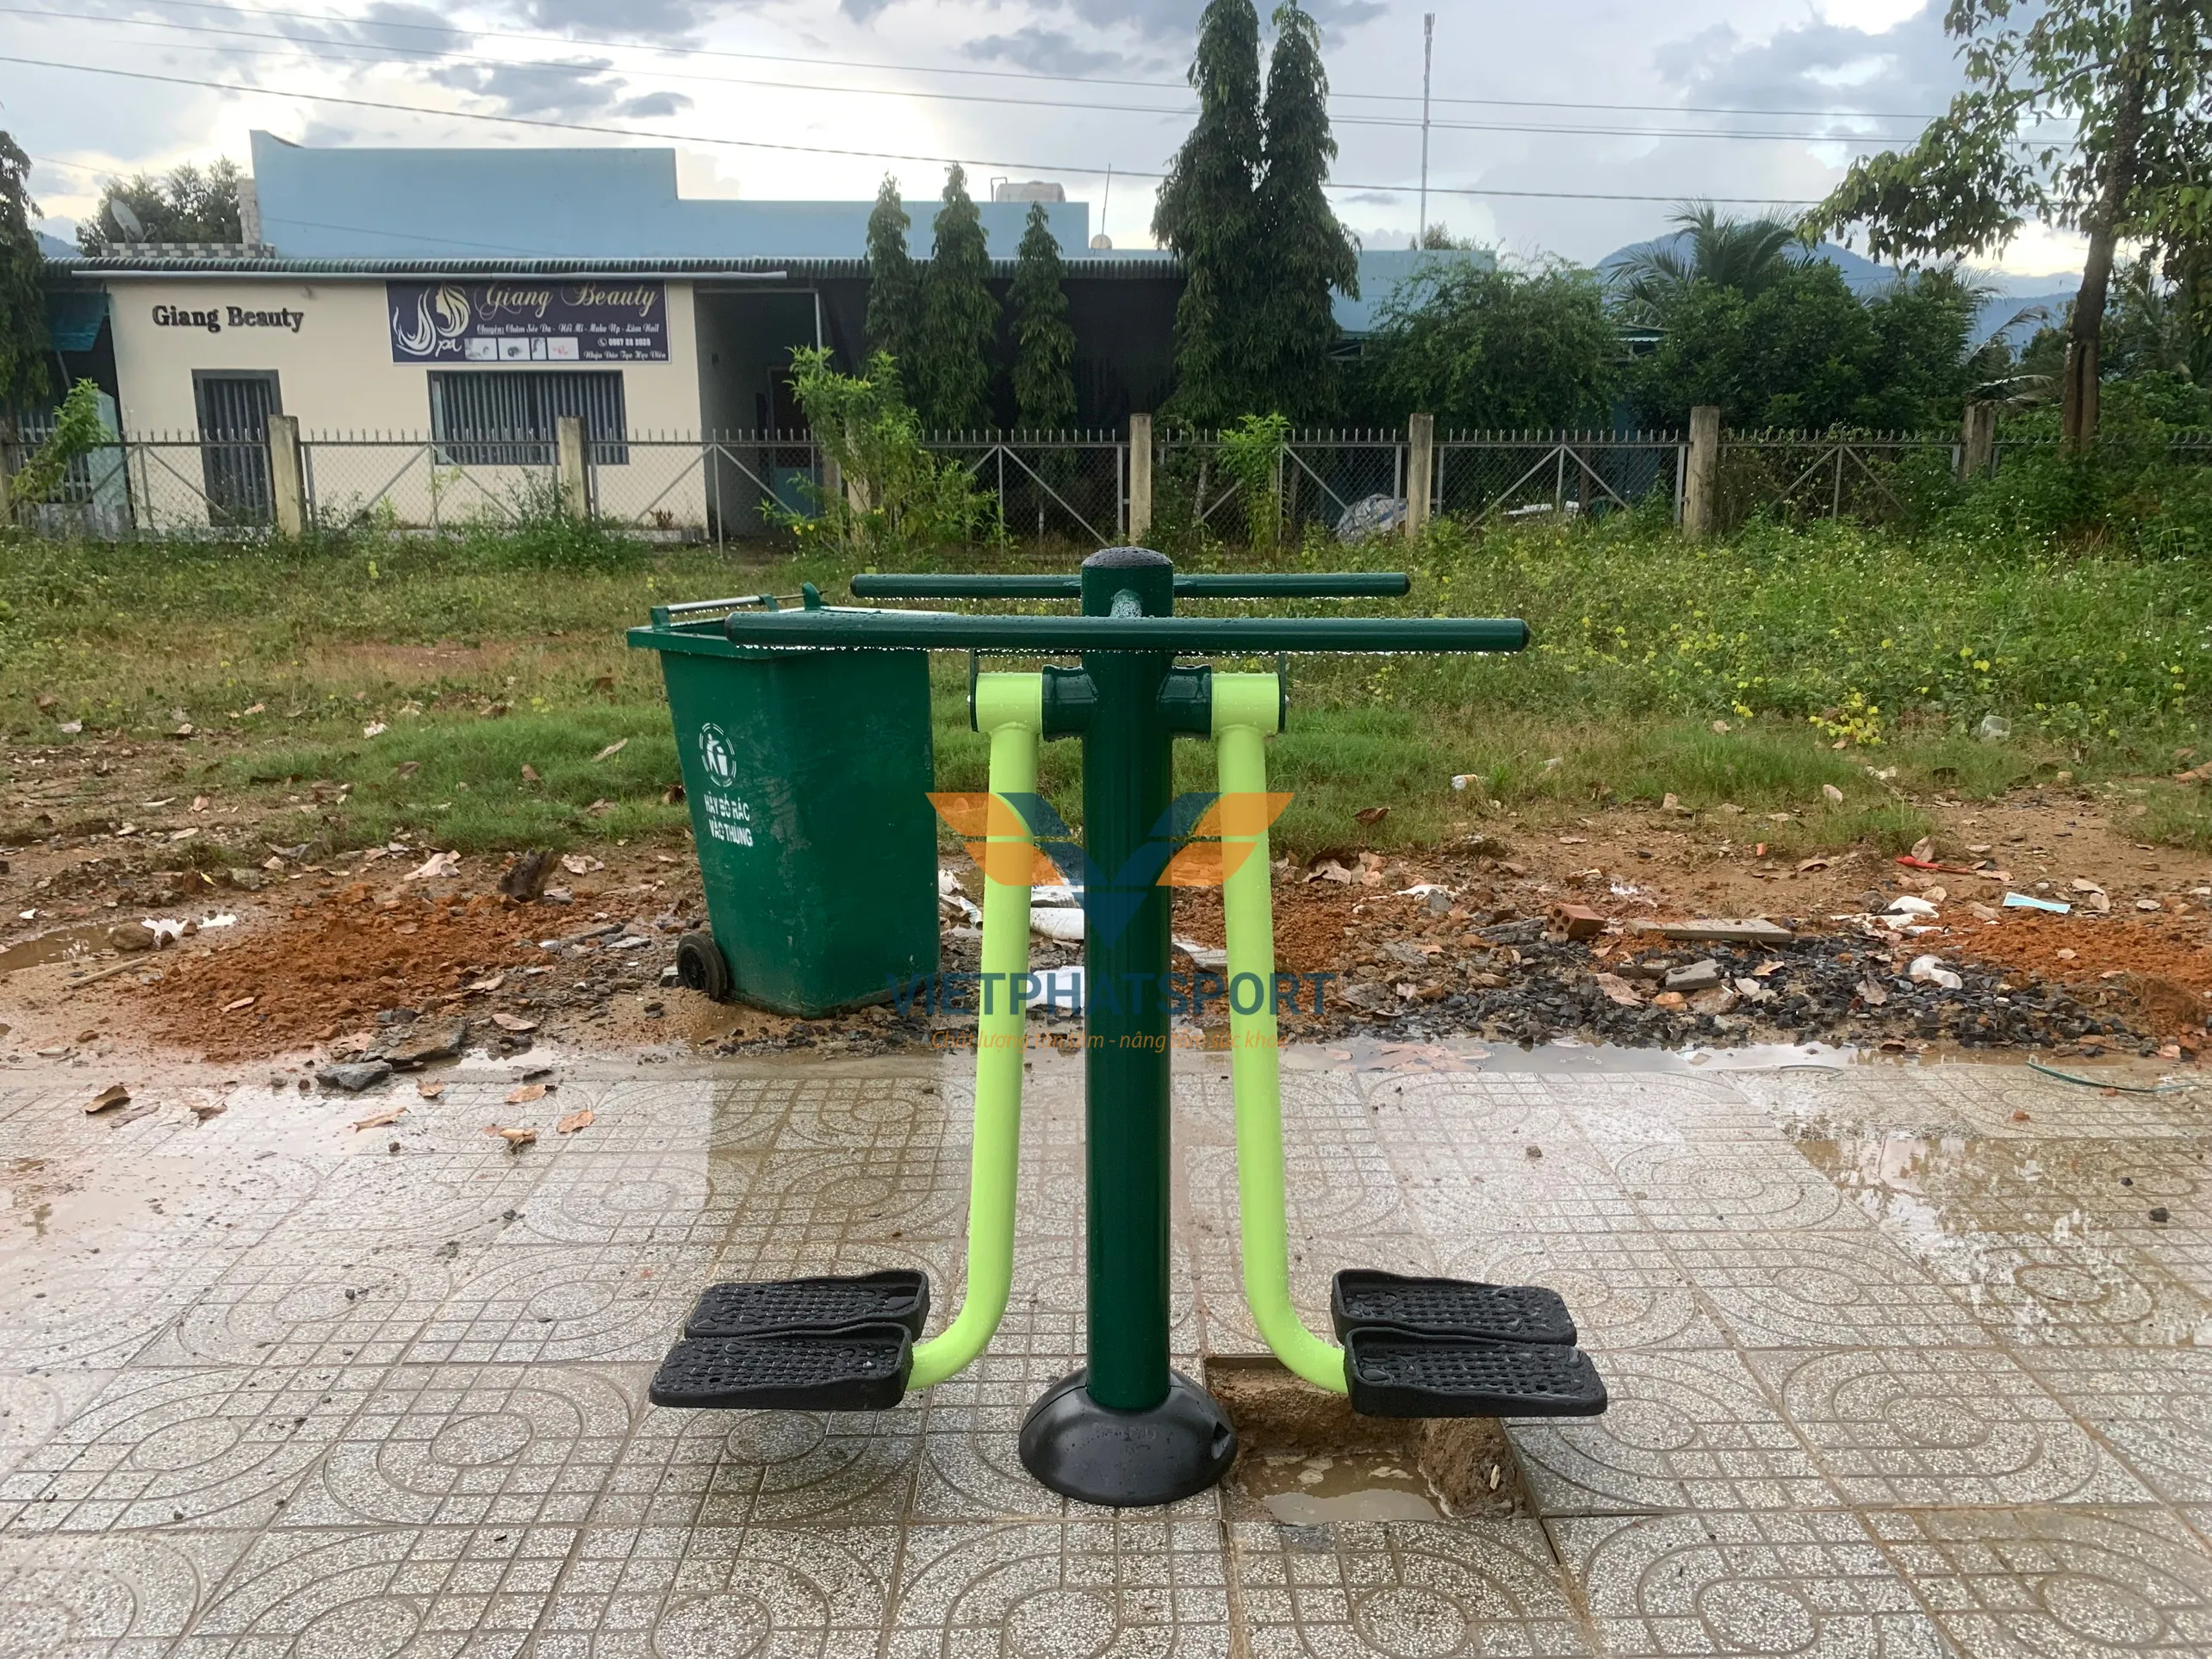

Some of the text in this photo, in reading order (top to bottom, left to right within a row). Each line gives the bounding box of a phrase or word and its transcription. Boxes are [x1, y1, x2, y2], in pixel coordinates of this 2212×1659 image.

[561, 282, 659, 317] Beauty
[152, 305, 304, 332] Giang Beauty
